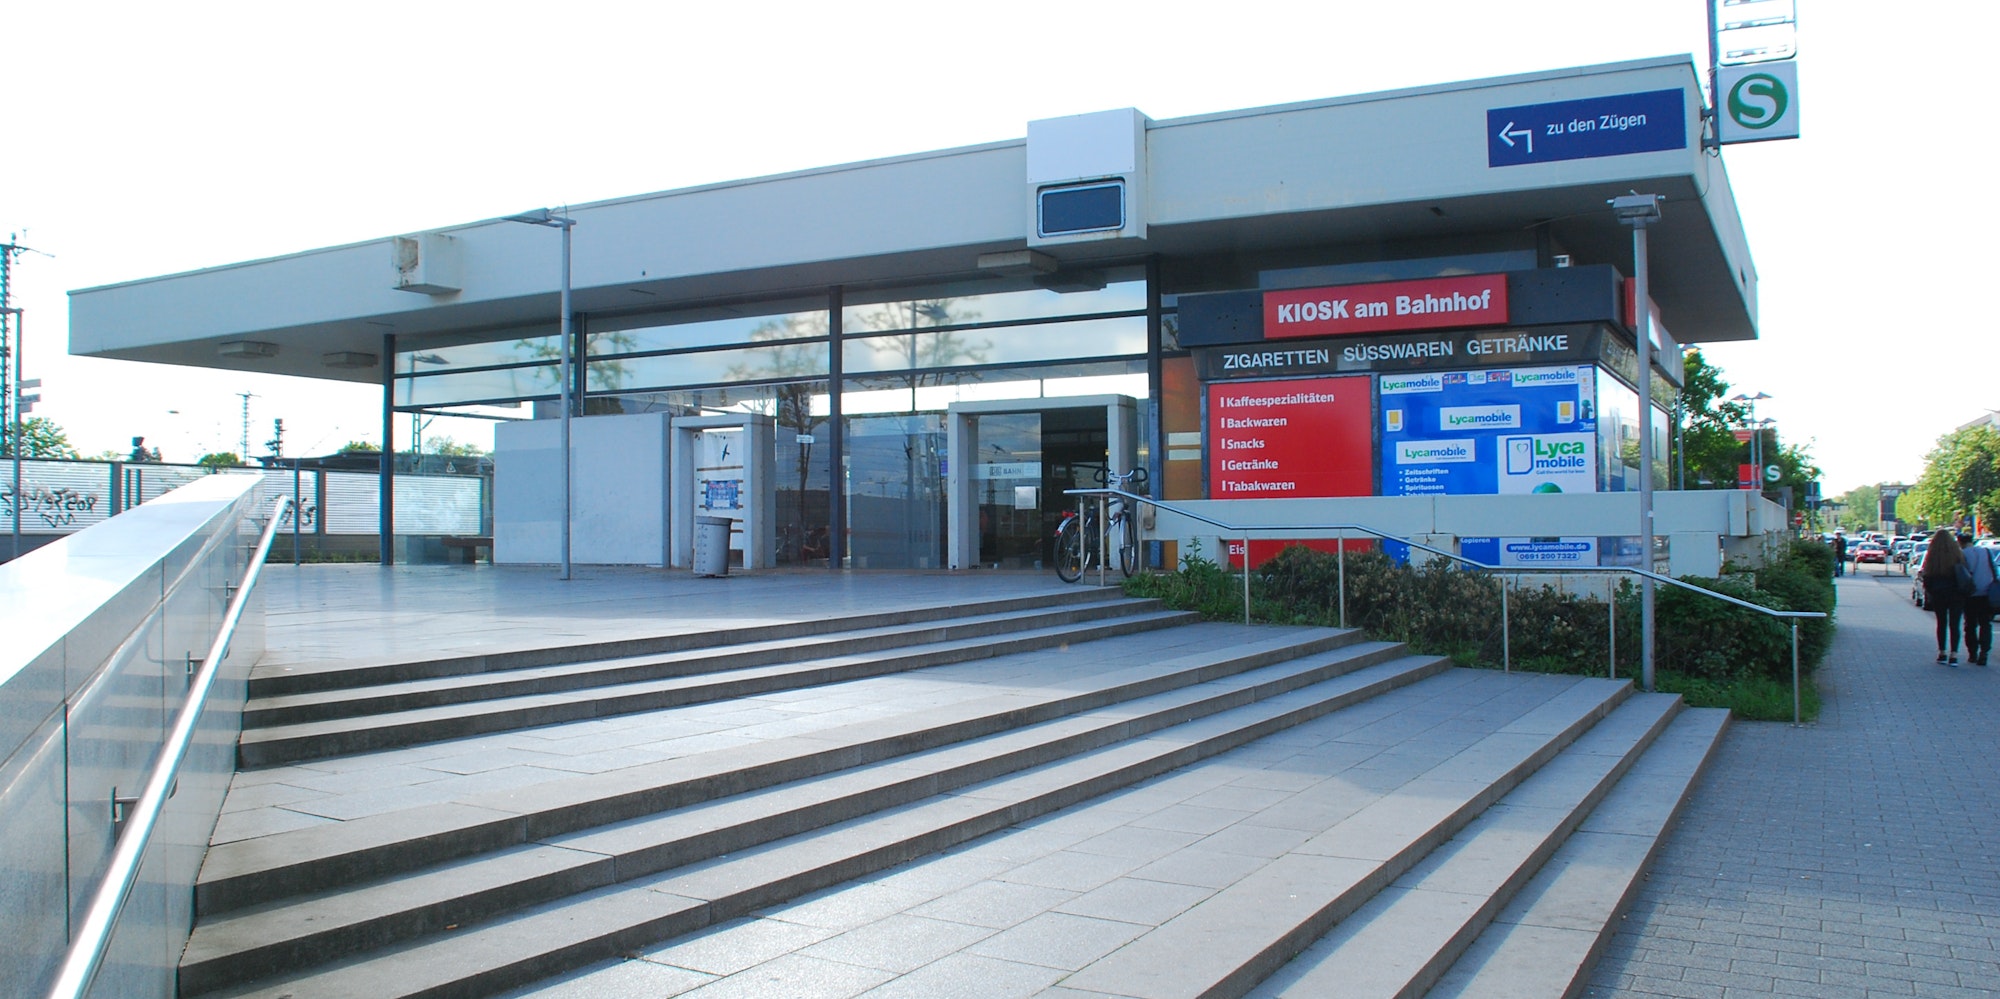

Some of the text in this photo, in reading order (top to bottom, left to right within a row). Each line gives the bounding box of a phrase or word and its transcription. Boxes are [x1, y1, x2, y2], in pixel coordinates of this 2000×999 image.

[1736, 74, 1779, 128] S
[1546, 112, 1647, 136] zu den Zügen
[1277, 289, 1492, 324] KIOSK am Bahnhof
[1223, 334, 1569, 370] ZIGARETTEN SÜSSWAREN GETRÄNKE
[1515, 369, 1576, 383] Lycamobile
[1382, 377, 1440, 391] Lycamobile
[1226, 392, 1335, 407] Kaffeespezialitäten
[1227, 417, 1287, 428] Backwaren
[1449, 412, 1512, 426] Lycamobile
[1227, 438, 1265, 450] Snacks
[1535, 439, 1585, 459] Lyca
[1405, 446, 1467, 459] Lycamobile
[1227, 458, 1279, 471] Getränke
[1536, 455, 1585, 468] mobile
[1765, 464, 1782, 481] S
[1227, 481, 1296, 492] Tabakwaren
[1229, 544, 1245, 555] Eis
[1510, 543, 1587, 551] www.lycamobile.de
